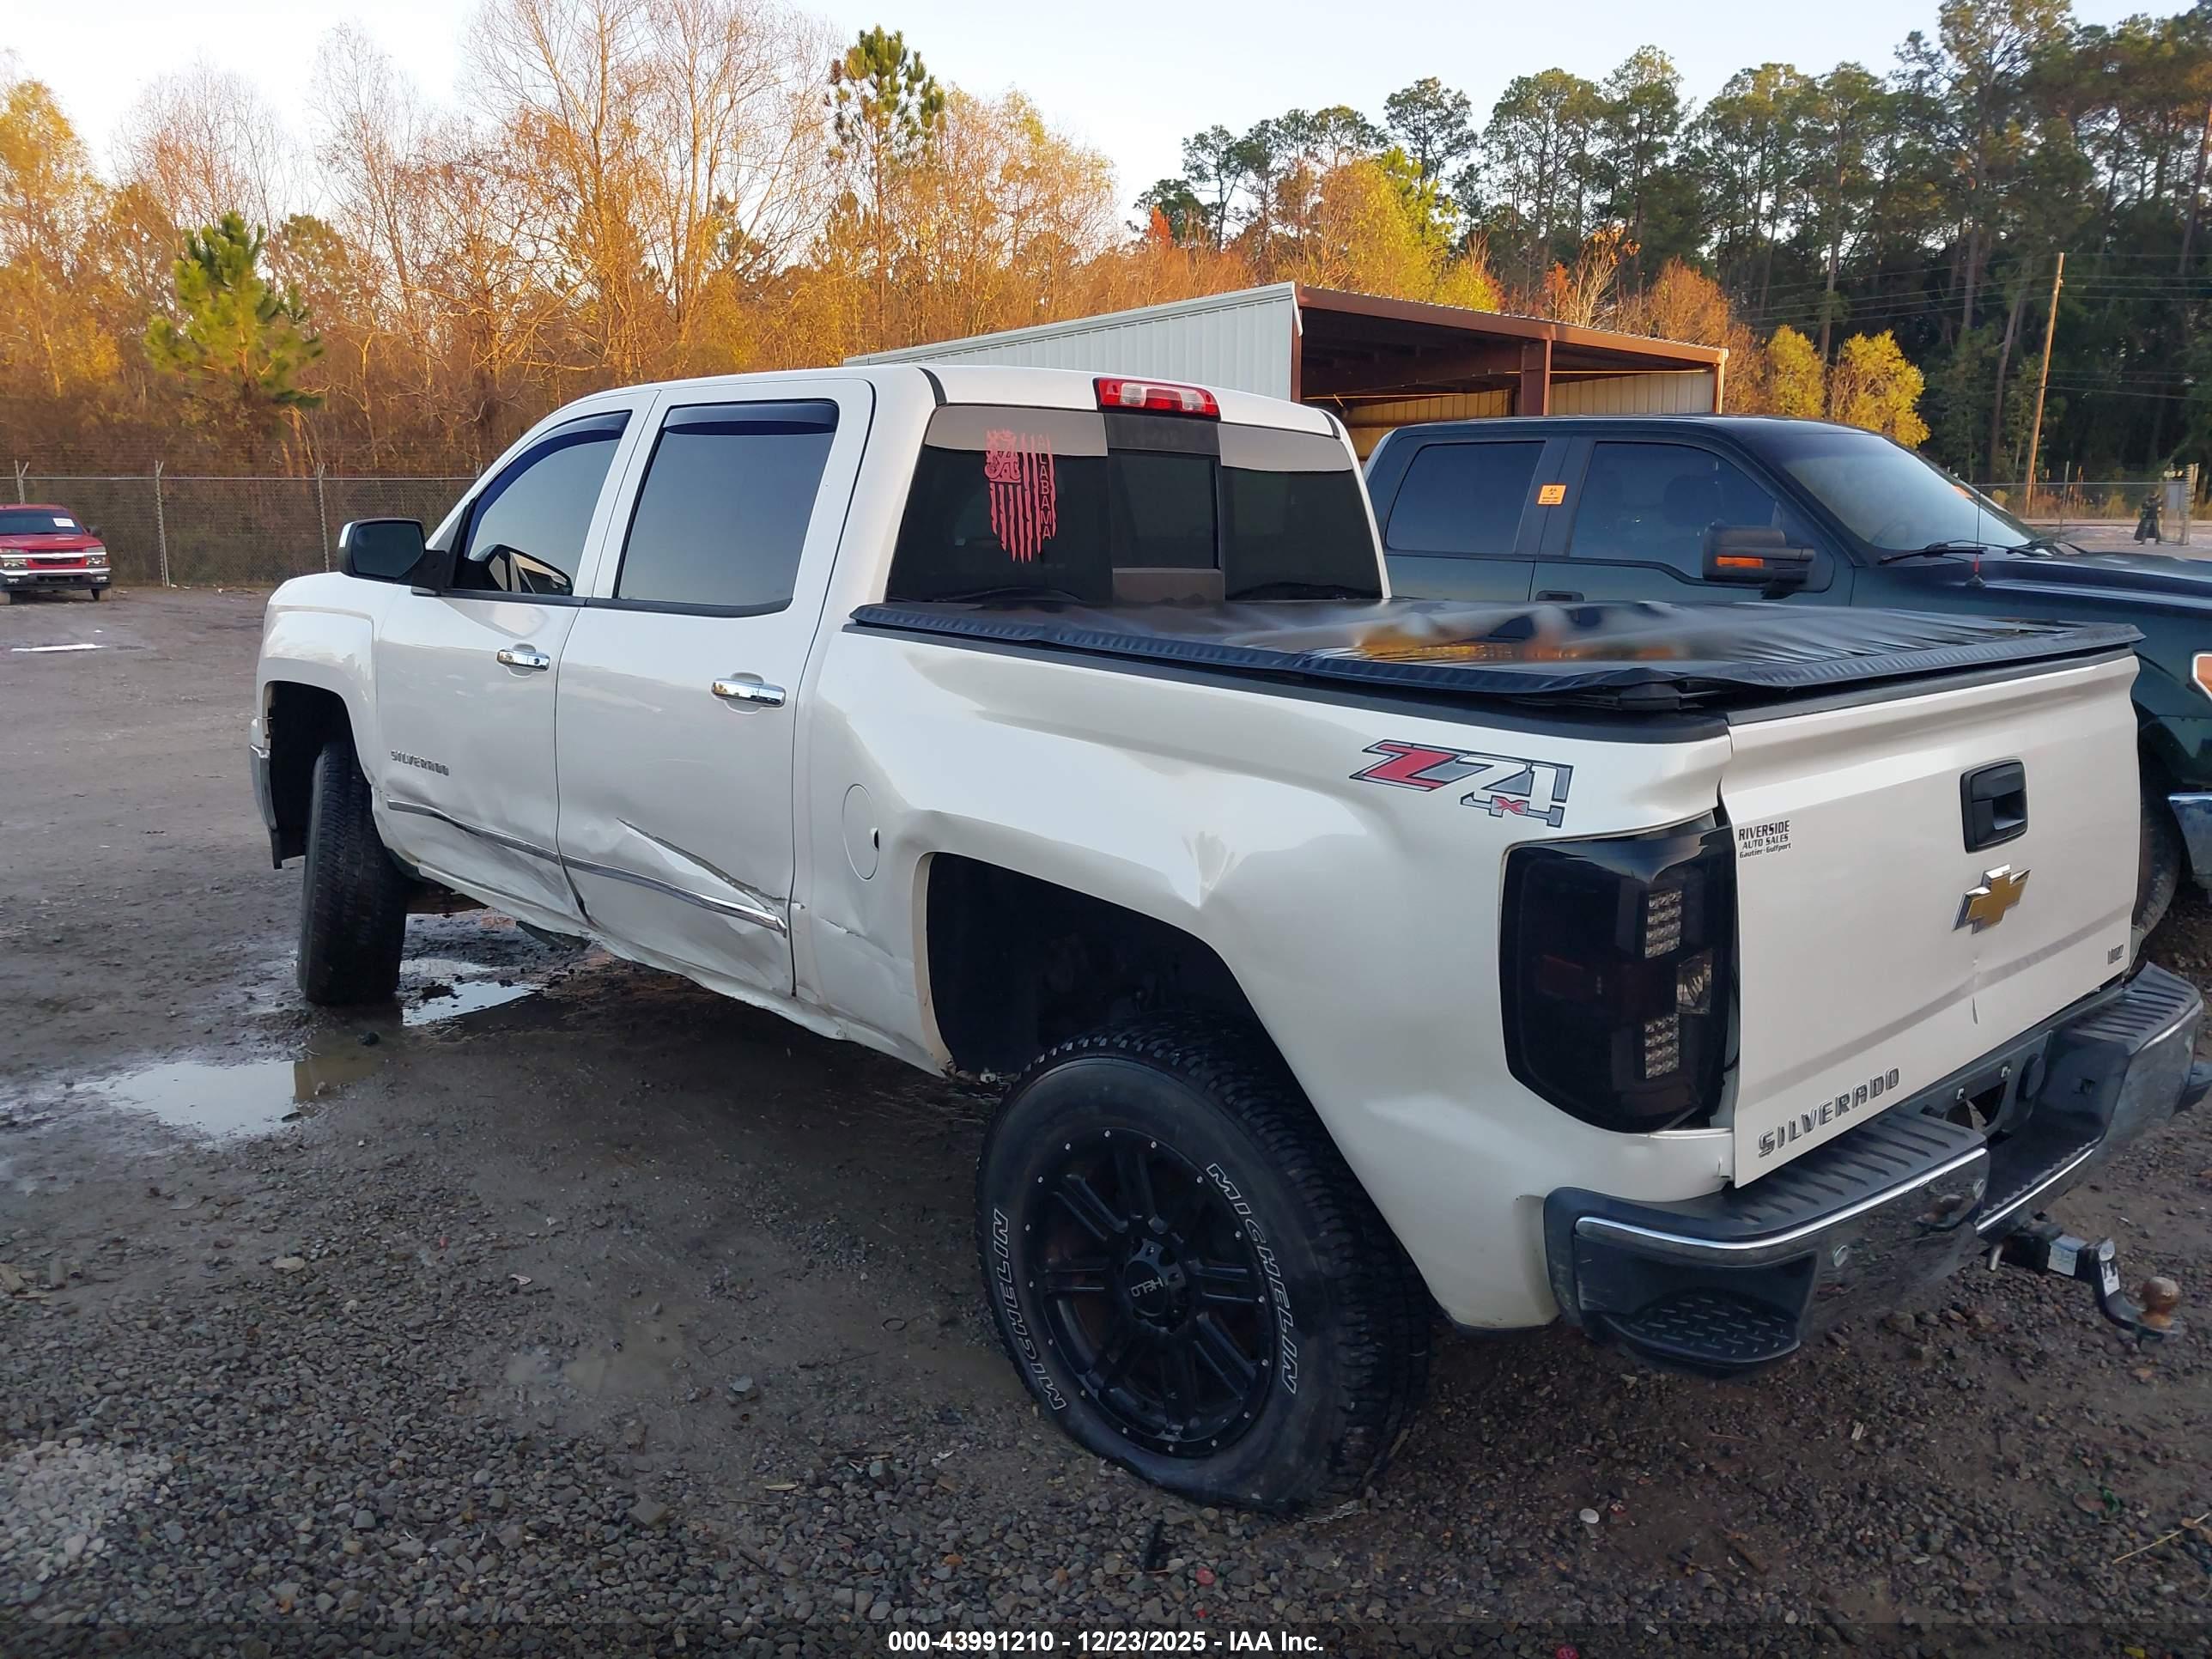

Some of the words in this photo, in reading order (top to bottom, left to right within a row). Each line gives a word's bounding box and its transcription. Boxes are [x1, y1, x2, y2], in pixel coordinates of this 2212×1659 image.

[1039, 434, 1052, 540] ALABAMA
[391, 750, 450, 777] SILVERADO
[1349, 739, 1575, 803] Z71
[1738, 820, 1790, 841] RIVERSIDE
[1742, 838, 1763, 849] AUTO
[1765, 833, 1789, 845] SALES
[1759, 1067, 1900, 1158] SILVERADO
[994, 1207, 1067, 1411] MICHELIN
[1130, 1276, 1164, 1297] HELO
[1206, 1163, 1298, 1395] MICHELIN
